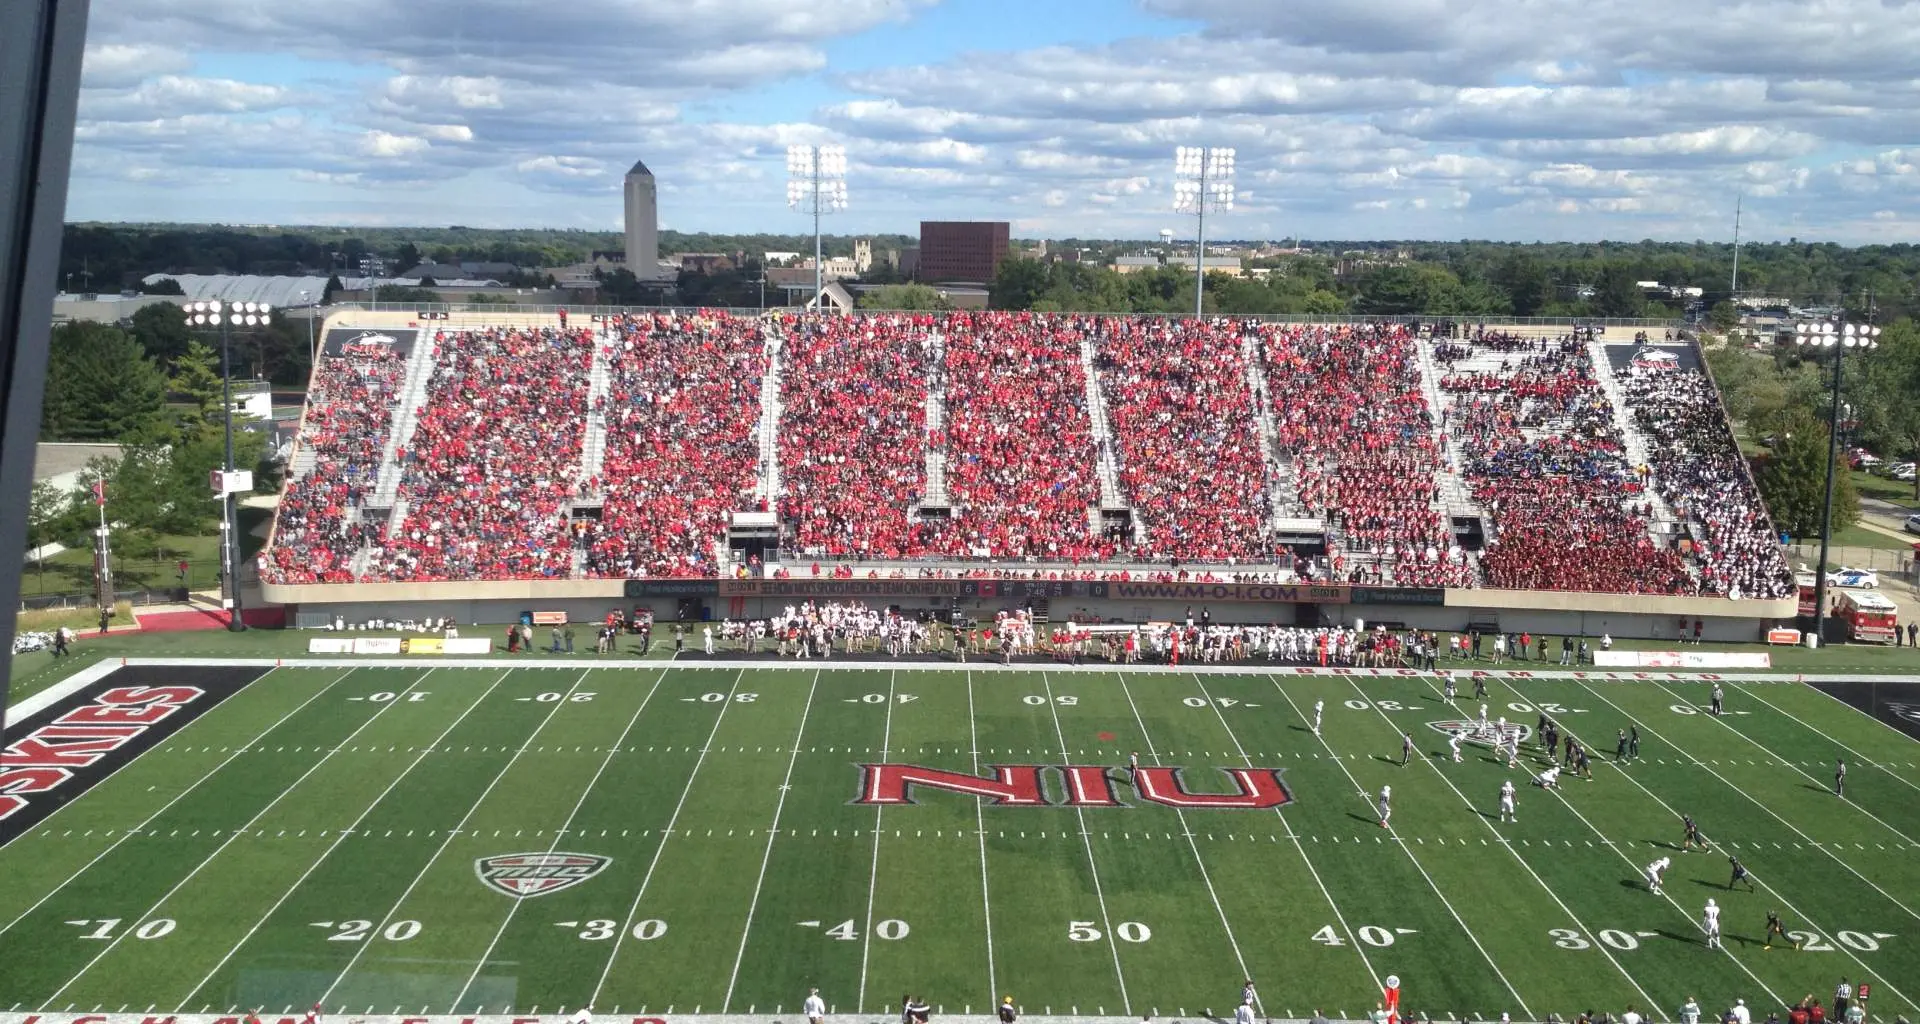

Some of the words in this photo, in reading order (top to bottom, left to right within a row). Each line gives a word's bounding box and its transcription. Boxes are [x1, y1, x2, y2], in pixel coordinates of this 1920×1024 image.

[1296, 668, 1533, 678] BRIGHAM
[1573, 672, 1721, 680] FIELD
[1023, 695, 1079, 706] 50
[0, 686, 206, 821] SKIES
[852, 763, 1293, 809] NIU
[79, 918, 177, 941] 10
[327, 919, 422, 942] 20
[578, 919, 668, 942] 30
[825, 918, 910, 941] 40
[1068, 921, 1152, 943] 50
[1311, 924, 1395, 947] 40
[1548, 928, 1640, 951] 30
[1798, 930, 1880, 952] 20
